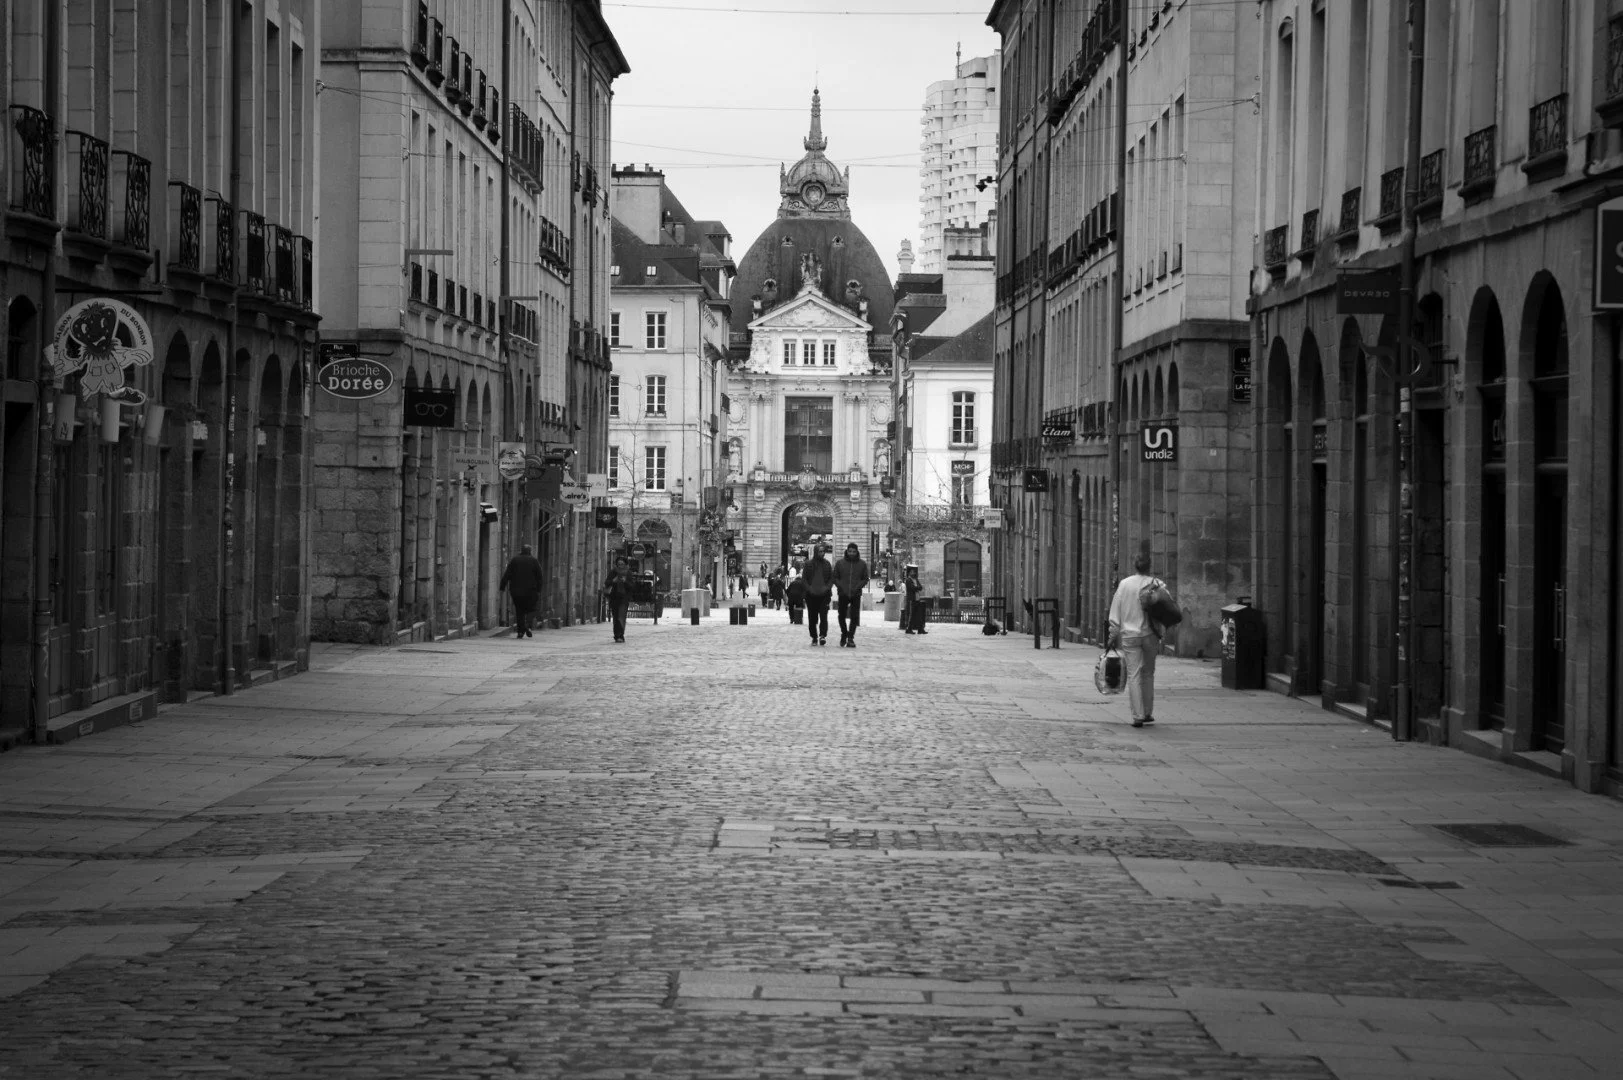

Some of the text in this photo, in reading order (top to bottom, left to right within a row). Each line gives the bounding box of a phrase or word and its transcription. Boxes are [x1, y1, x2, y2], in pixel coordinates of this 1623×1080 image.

[54, 314, 72, 343] MAISON
[120, 308, 131, 318] DU
[130, 317, 147, 345] BONBON
[333, 364, 380, 376] Brioche
[328, 377, 384, 390] Dorée
[1042, 427, 1071, 436] Etam
[1145, 449, 1173, 459] undiz
